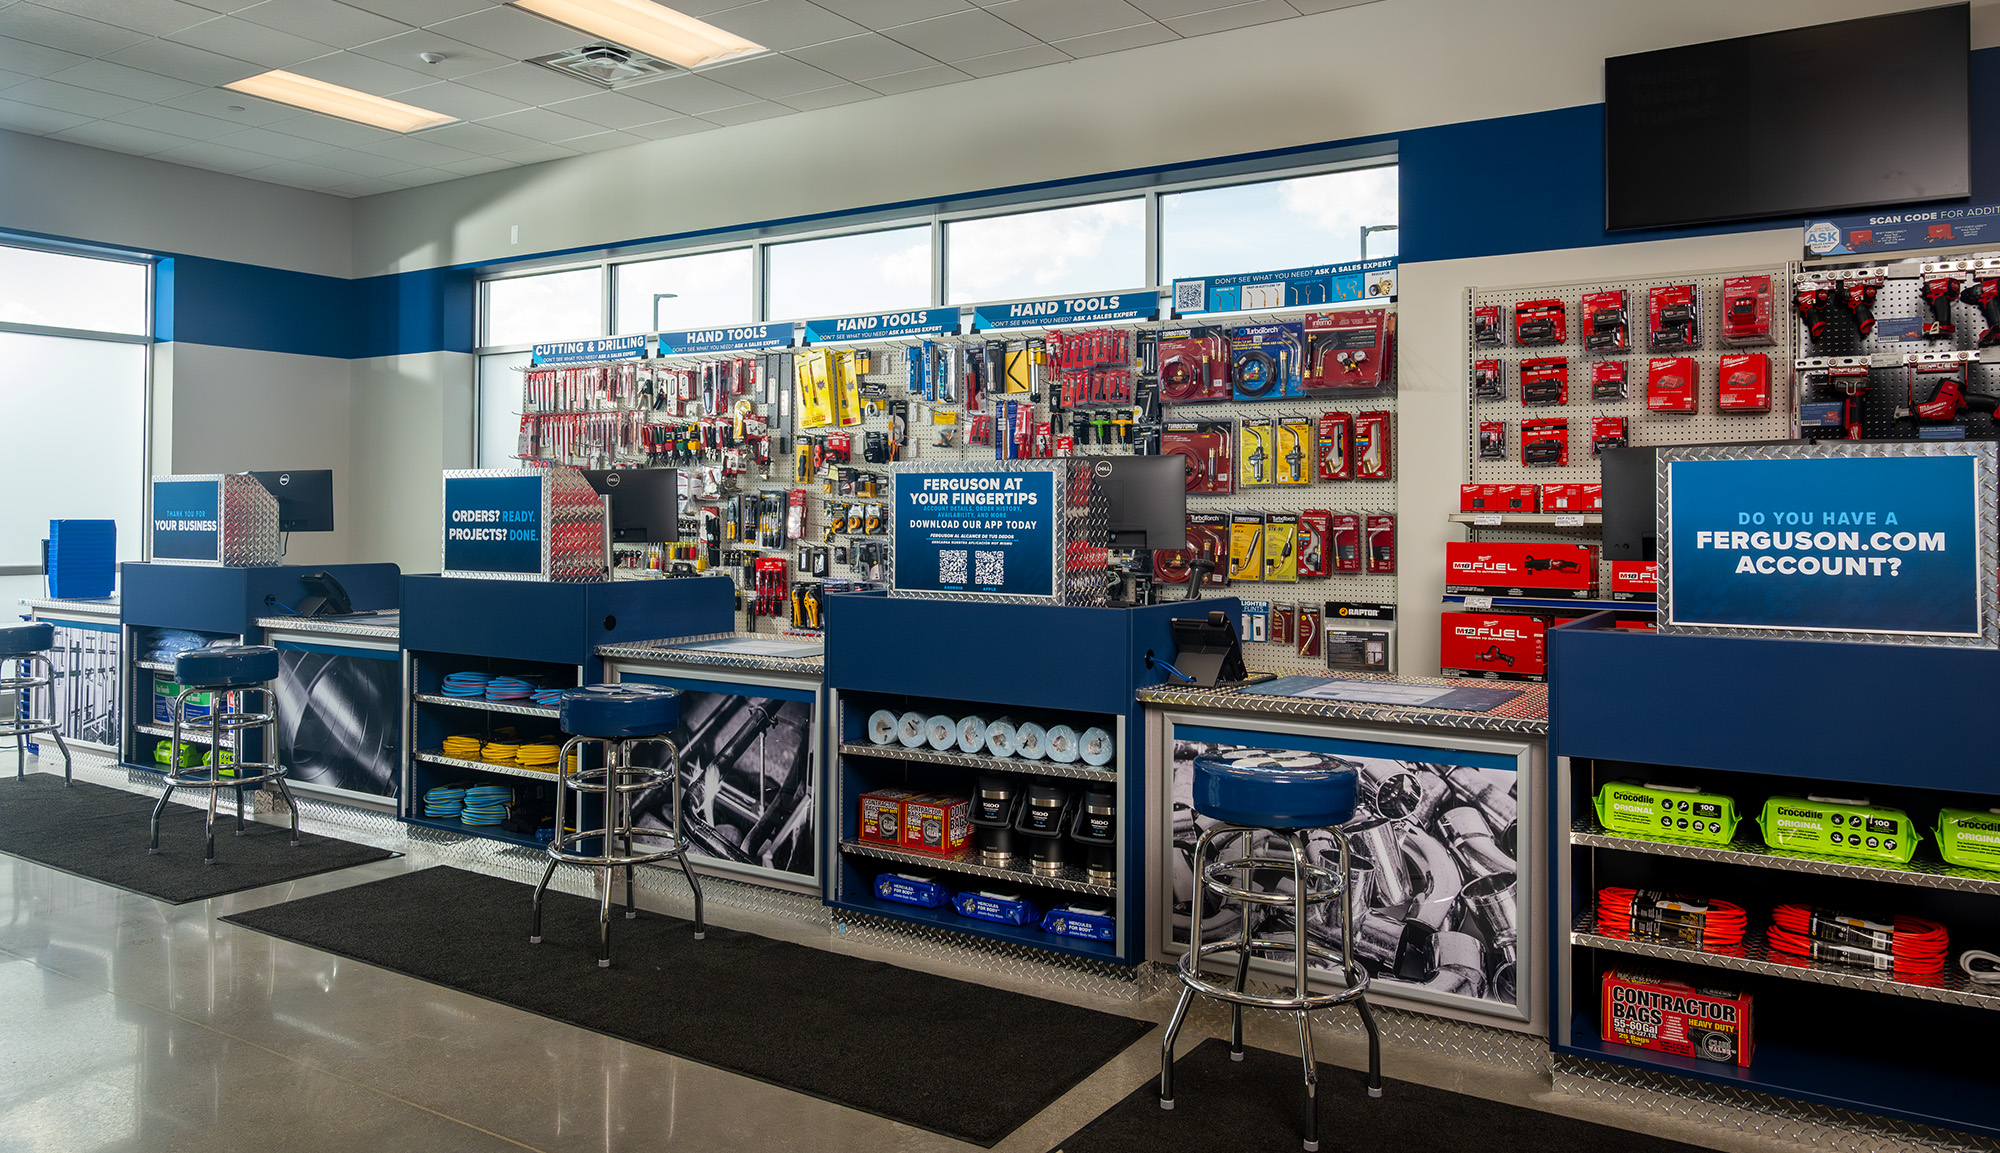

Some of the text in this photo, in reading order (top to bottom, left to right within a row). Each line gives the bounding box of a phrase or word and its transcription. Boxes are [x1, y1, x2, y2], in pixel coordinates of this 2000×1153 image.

[1870, 215, 1901, 225] SCAN
[1904, 212, 1937, 222] CODE
[1940, 209, 1963, 219] FOR
[1806, 232, 1837, 244] ASK
[1252, 274, 1273, 282] WHAT
[1291, 270, 1313, 278] NEED?
[1338, 264, 1361, 273] SALES
[1363, 260, 1392, 269] EXPERT
[1010, 296, 1120, 317] HAND TOOLS
[836, 311, 927, 331] HAND TOOLS
[687, 326, 767, 344] HAND TOOLS
[1246, 326, 1278, 334] TurboTorch
[536, 336, 644, 355] CUTTING & DRILLING
[1651, 360, 1676, 368] Milwaukee
[1723, 356, 1749, 365] Milwaukee
[1920, 402, 1947, 412] Milwaukee
[924, 478, 1023, 490] FERGUSON AT
[910, 492, 1037, 505] YOUR FINGERTIPS
[452, 510, 535, 522] ORDERS? READY.
[1738, 512, 1898, 525] DO YOU HAVE A
[155, 520, 217, 532] YOUR BUSINESS
[910, 520, 1037, 529] DOWNLOAD OUR APP TODAY
[449, 528, 538, 541] PROJECTS? DONE.
[1697, 531, 1945, 551] FERGUSON.COM
[1473, 563, 1517, 571] FUEL
[1735, 556, 1902, 577] ACCOUNT?
[1478, 628, 1527, 638] FUEL
[864, 798, 898, 809] CONTRACTOR
[1614, 792, 1654, 804] Crocodile
[908, 804, 942, 816] CONTRACTOR
[1614, 804, 1654, 814] ORIGINAL
[1777, 807, 1823, 819] Crocodile
[1777, 820, 1823, 830] ORIGINAL
[1612, 986, 1736, 1023] CONTRACTOR
[1613, 1002, 1663, 1026] BAGS
[1614, 1019, 1642, 1031] 55-60
[1642, 1022, 1658, 1034] Gal
[1688, 1018, 1713, 1030] HEAVY
[1714, 1022, 1735, 1033] DUTY
[1630, 1035, 1650, 1044] Bags
[1708, 1040, 1731, 1049] CLUB
